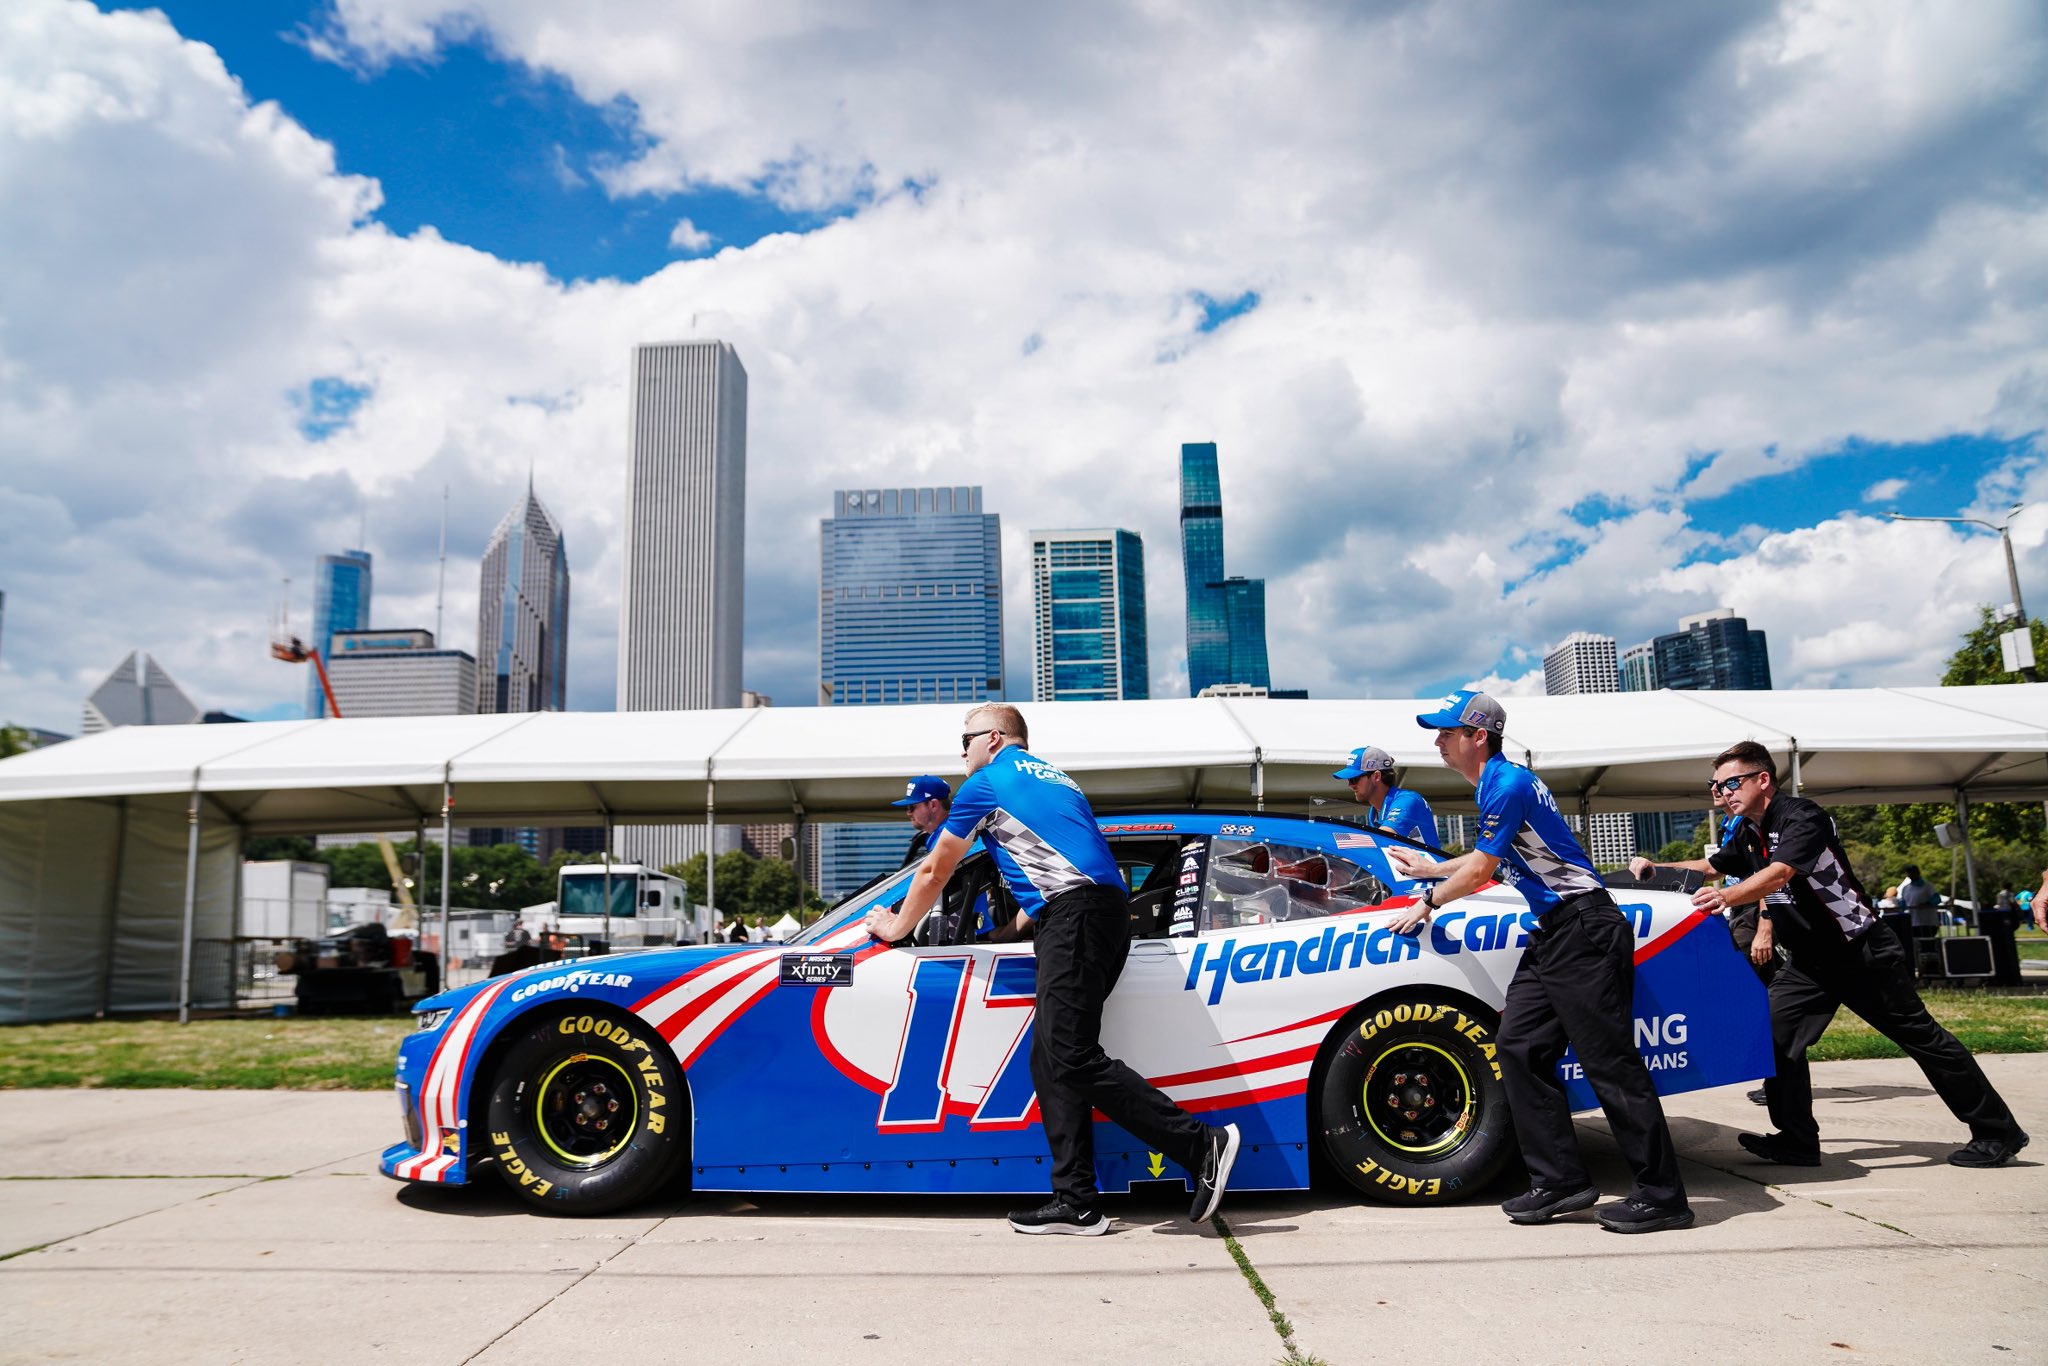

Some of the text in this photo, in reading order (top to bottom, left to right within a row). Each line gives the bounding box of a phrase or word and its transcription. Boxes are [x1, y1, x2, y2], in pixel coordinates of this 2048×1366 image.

[1467, 710, 1486, 725] 17
[1099, 824, 1175, 832] arson
[791, 957, 841, 980] xfinity
[1184, 922, 1420, 1006] Hendrick
[511, 970, 633, 1002] GOODYEAR
[875, 955, 1039, 1134] 17
[559, 1016, 667, 1134] GOODYEAR
[491, 1131, 553, 1197] EAGLE
[1356, 1157, 1441, 1195] EAGLE
